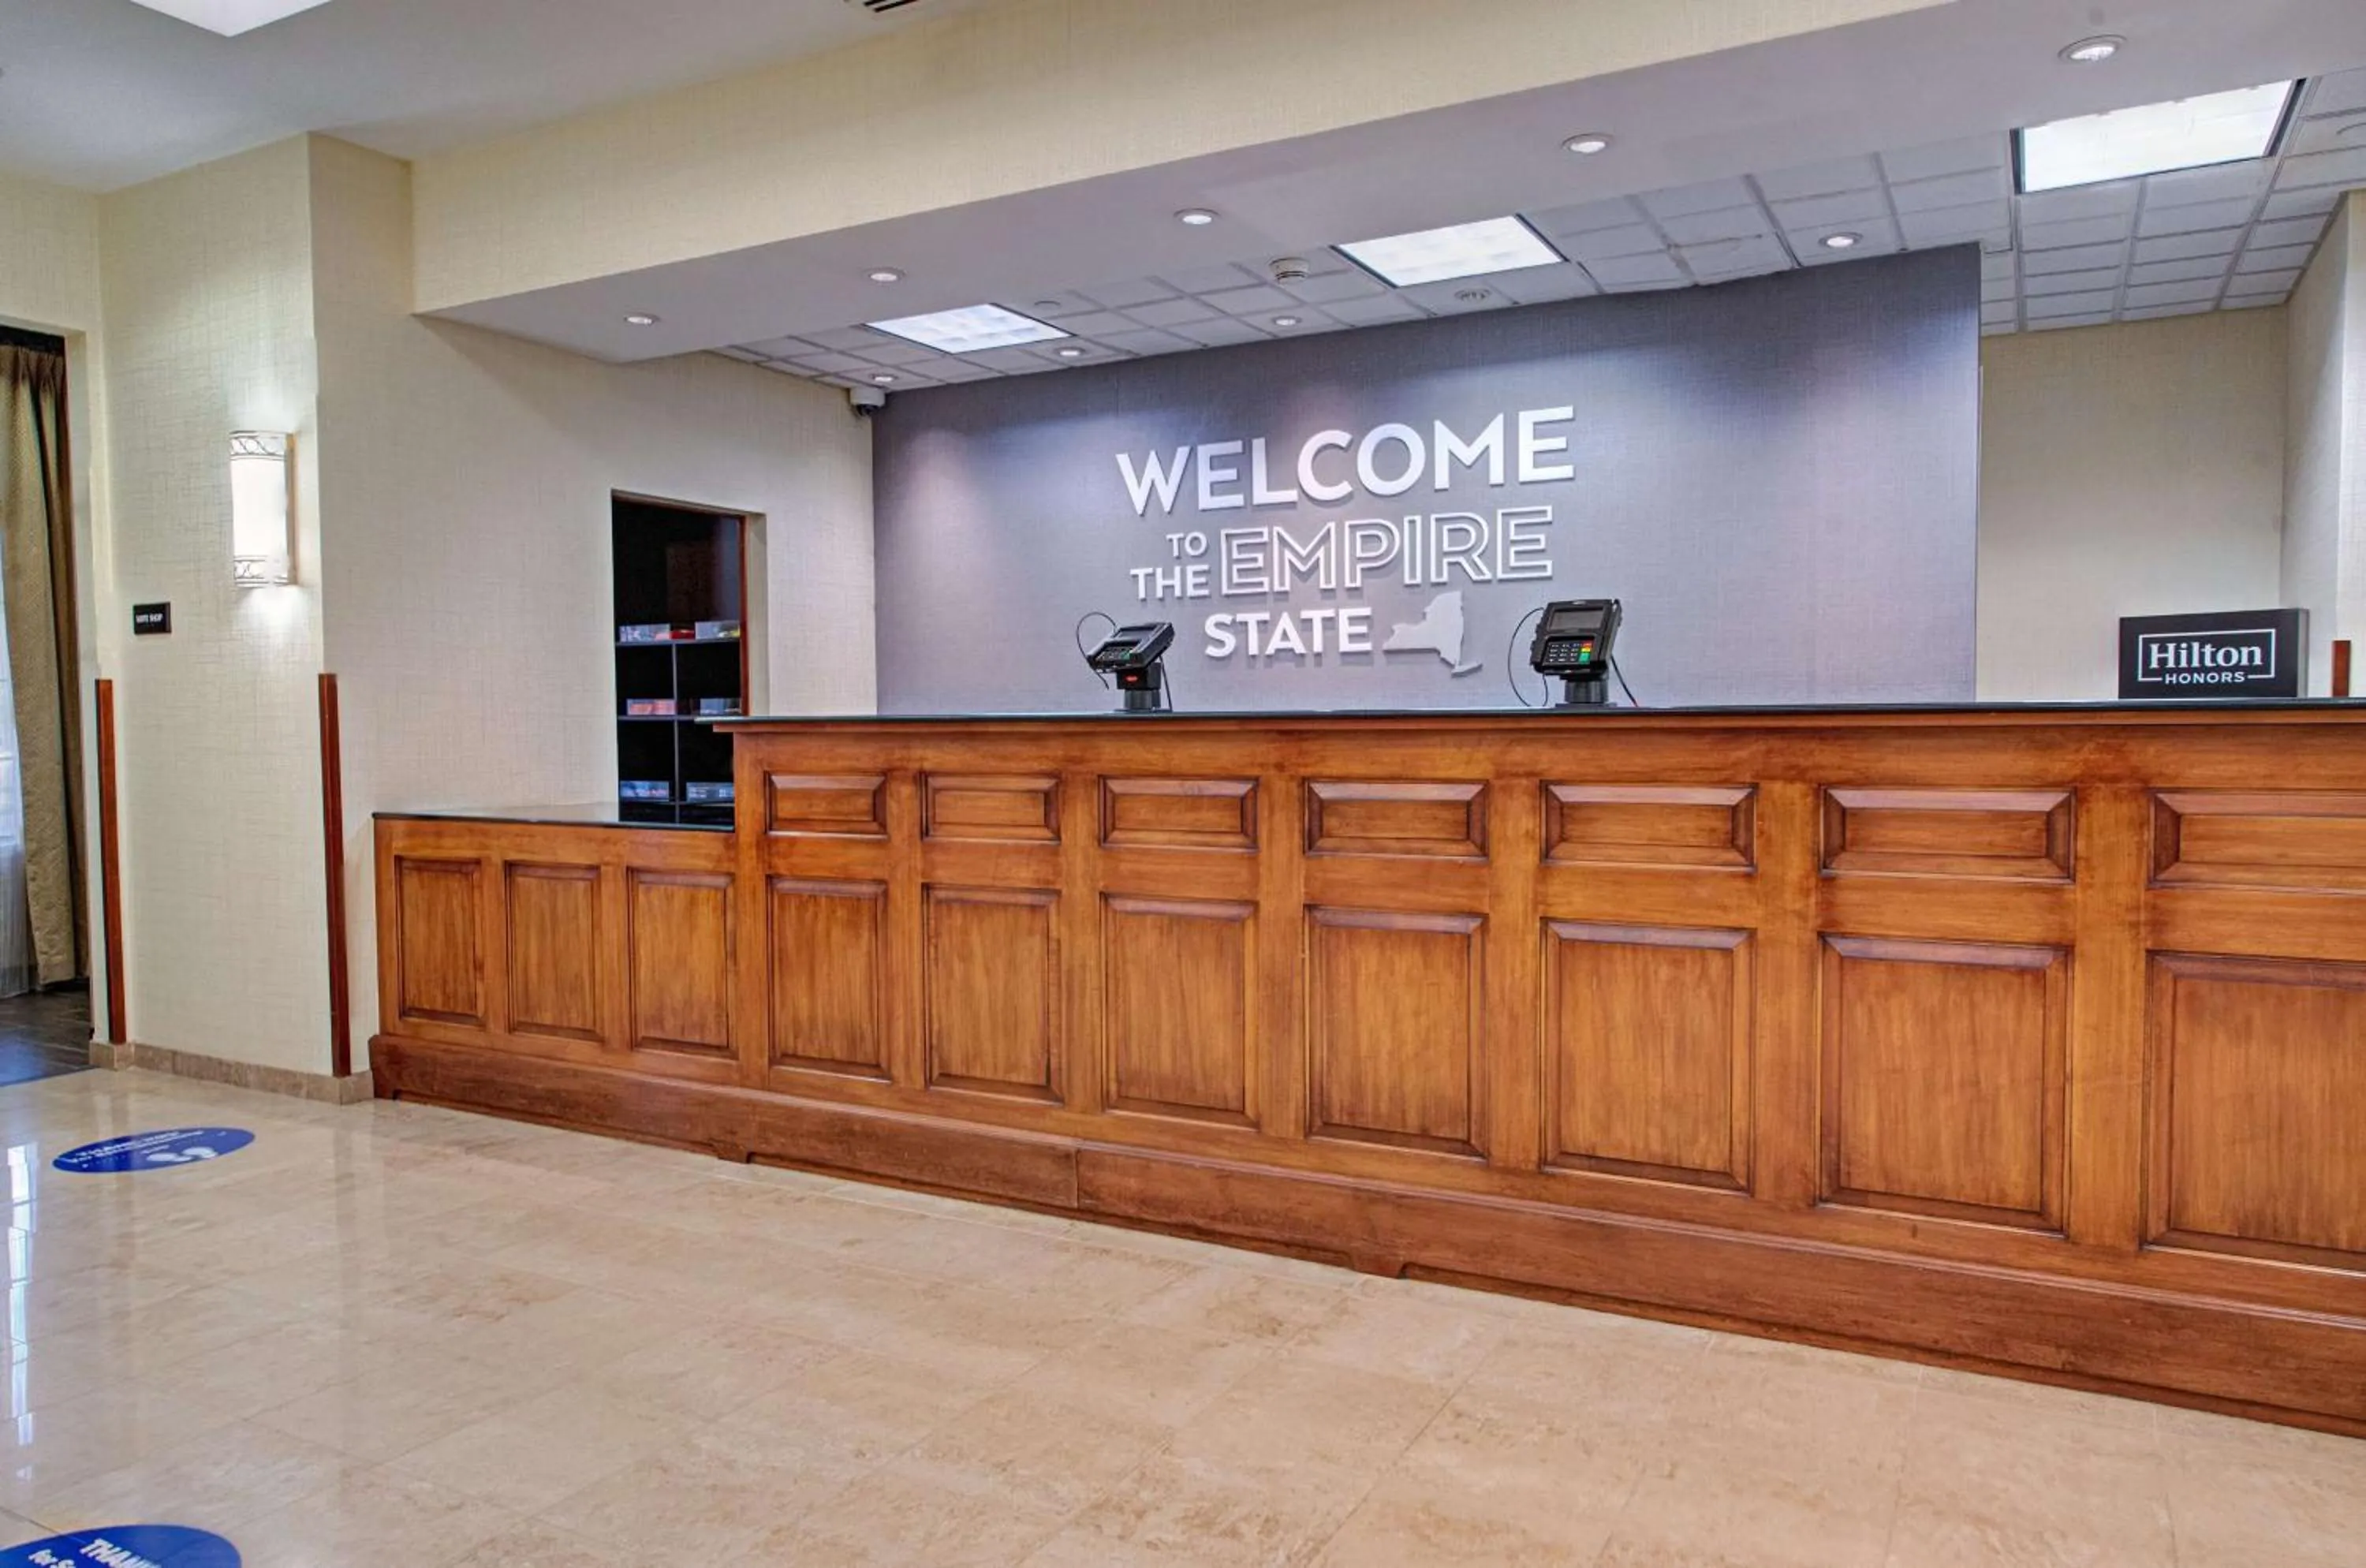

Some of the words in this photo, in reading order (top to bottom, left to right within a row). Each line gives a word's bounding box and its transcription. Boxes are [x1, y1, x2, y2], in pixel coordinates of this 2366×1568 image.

[1116, 405, 1574, 515] WELCOME
[1130, 564, 1210, 600] THE
[1220, 505, 1553, 596] EMPIRE
[1166, 532, 1207, 558] TO
[1204, 607, 1373, 659] STATE
[2148, 641, 2263, 669] Hilton
[2164, 671, 2246, 685] HONORS
